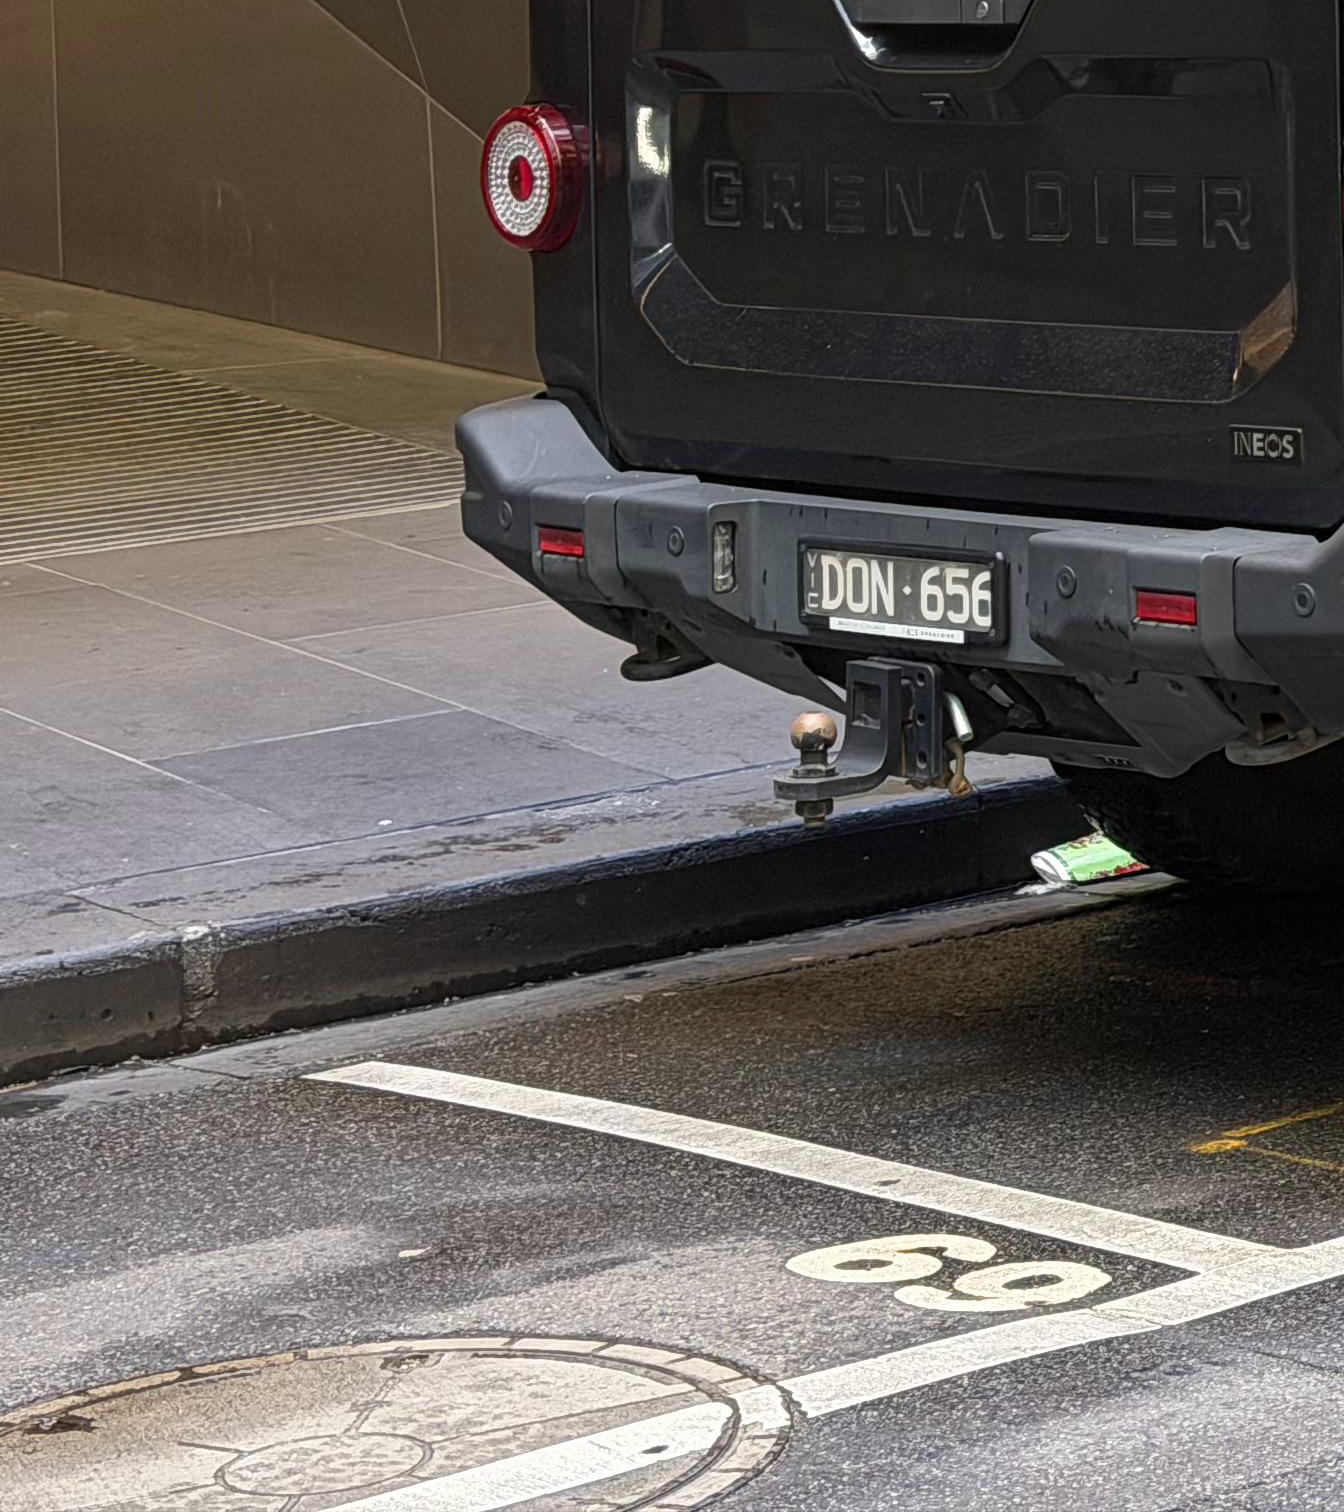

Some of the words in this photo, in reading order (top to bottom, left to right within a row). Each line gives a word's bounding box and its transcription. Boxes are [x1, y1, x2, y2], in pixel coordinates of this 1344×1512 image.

[702, 158, 1253, 251] GRENADIER
[1232, 430, 1295, 460] INEOS
[807, 552, 820, 609] VIC
